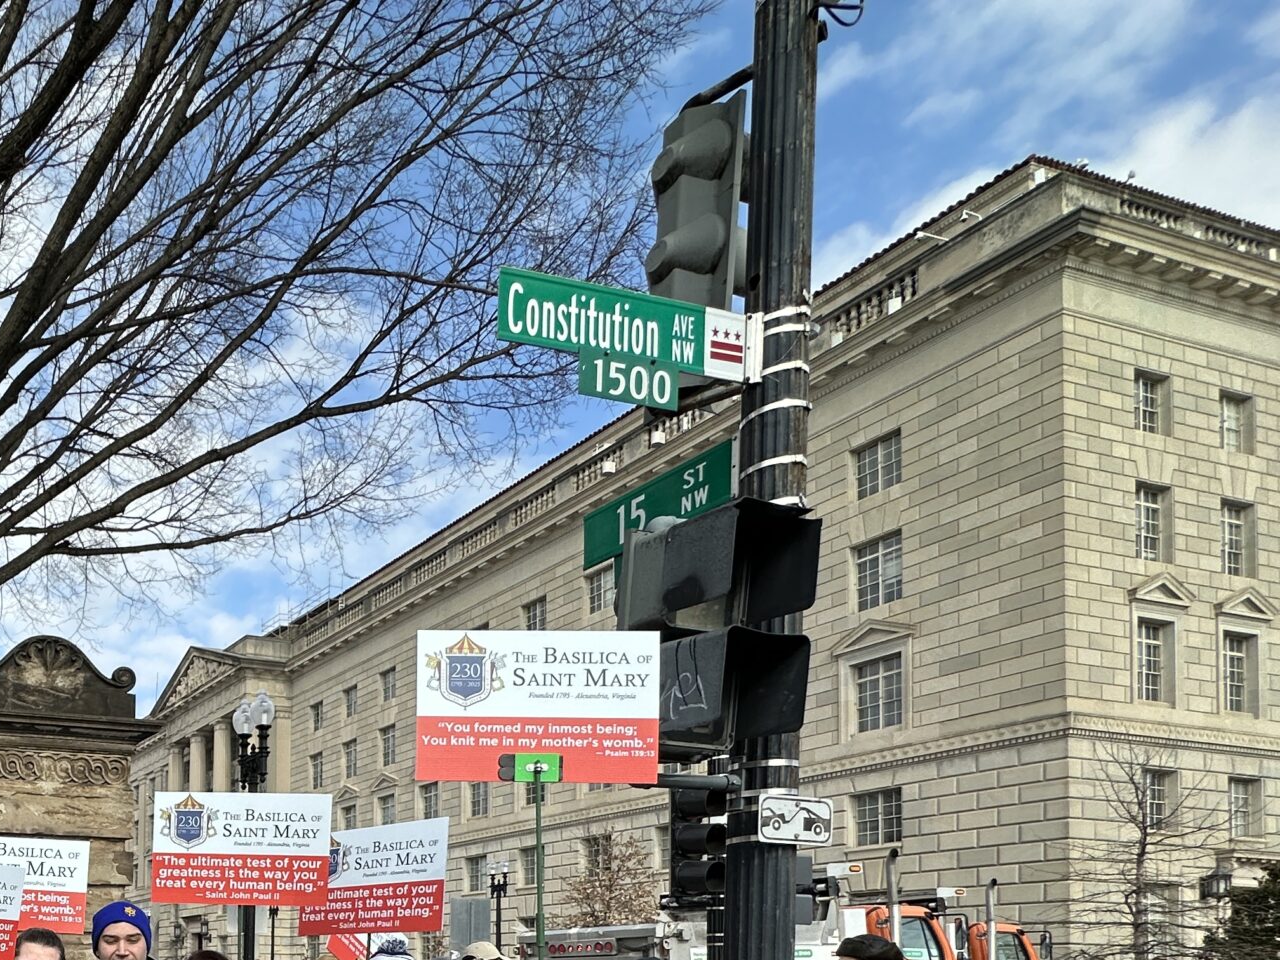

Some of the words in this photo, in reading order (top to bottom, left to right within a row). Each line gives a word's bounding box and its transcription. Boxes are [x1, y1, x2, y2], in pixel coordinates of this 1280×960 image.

[508, 282, 659, 358] Constitution
[672, 313, 695, 340] AVE
[671, 338, 695, 365] NW
[593, 358, 670, 404] 1500
[682, 461, 708, 489] ST
[680, 485, 709, 515] NW
[511, 651, 538, 663] THE
[544, 647, 630, 665] BASILICA
[636, 654, 653, 664] OF
[451, 663, 481, 678] 230
[513, 667, 576, 687] SAINT
[584, 668, 649, 687] MARY
[528, 691, 555, 699] Founded
[611, 692, 637, 701] Virginia
[474, 722, 521, 733] formed
[524, 725, 545, 735] my
[548, 723, 593, 734] inmost
[596, 723, 637, 736] being;
[421, 735, 447, 746] You
[450, 735, 475, 746] knit
[479, 738, 499, 746] me
[502, 735, 514, 746] in
[518, 738, 538, 749] my
[604, 749, 629, 757] Psalm
[178, 815, 200, 828] 230
[222, 811, 241, 821] THE
[245, 808, 307, 823] BASILICA
[310, 815, 323, 823] OF
[222, 823, 268, 838] SAINT
[273, 824, 320, 839] MARY
[354, 845, 370, 855] THE
[372, 839, 425, 854] BASILICA
[428, 839, 439, 847] OF
[67, 851, 81, 860] OF
[190, 856, 243, 867] ultimate
[246, 858, 272, 868] test
[275, 857, 289, 868] of
[292, 860, 322, 870] your
[354, 857, 392, 871] SAINT
[395, 852, 436, 867] MARY
[26, 860, 77, 878] MARY
[37, 892, 70, 905] being;
[302, 912, 325, 922] treat
[327, 911, 356, 921] every
[358, 909, 394, 919] human
